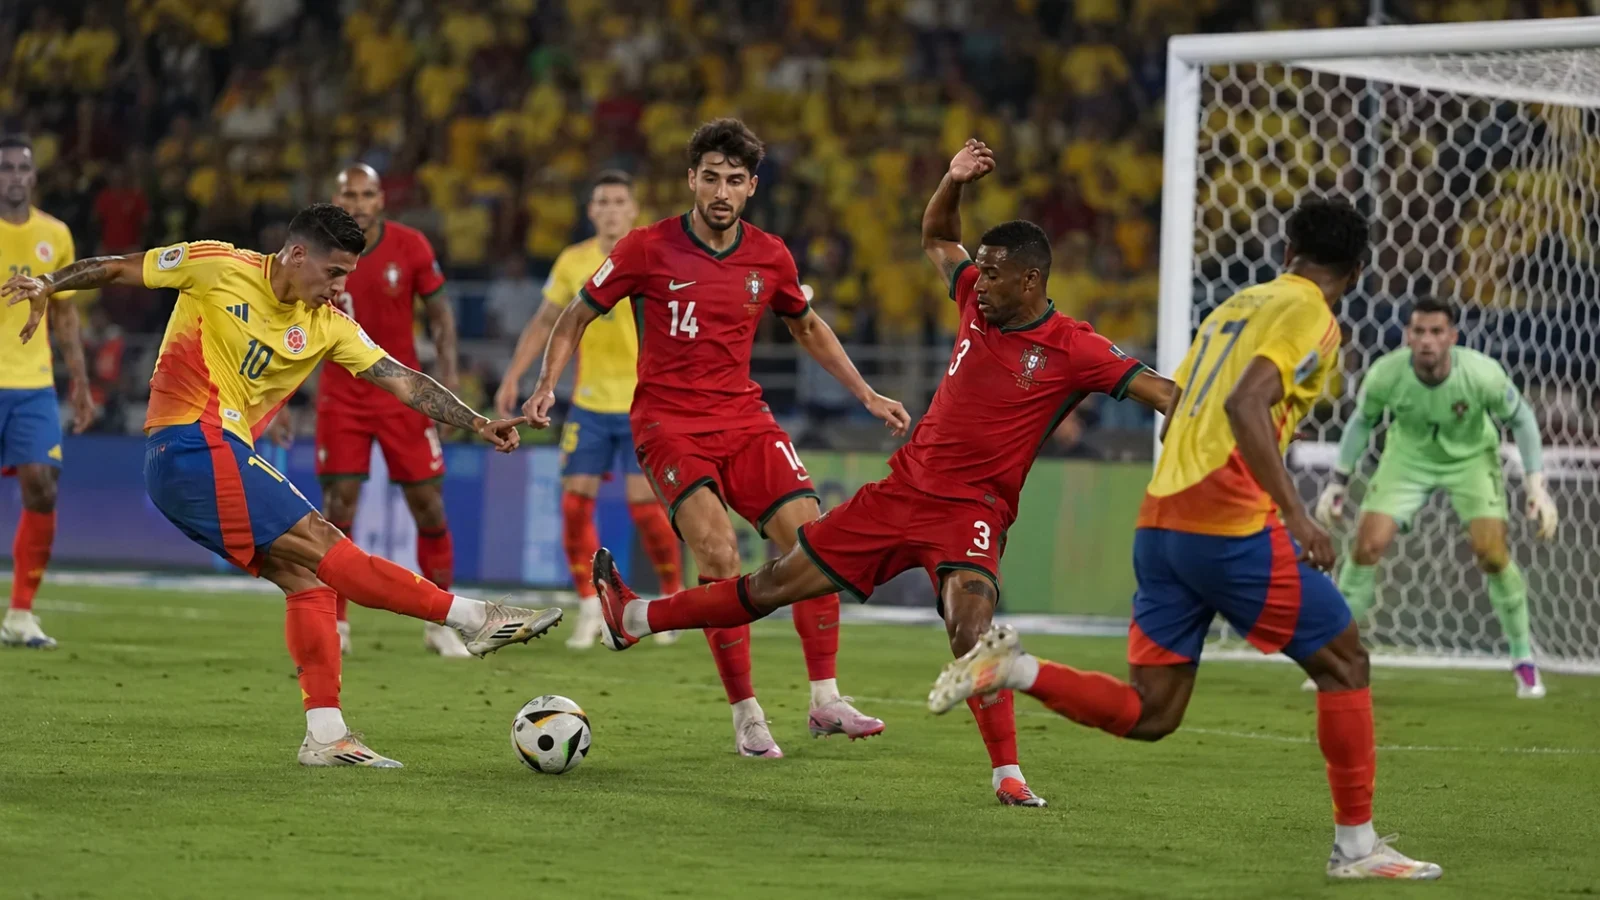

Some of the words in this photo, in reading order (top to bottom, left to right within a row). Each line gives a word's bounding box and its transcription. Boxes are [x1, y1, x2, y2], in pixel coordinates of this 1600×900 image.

[667, 300, 699, 338] 14
[239, 339, 274, 380] 10
[948, 338, 971, 376] 3
[1181, 318, 1249, 418] 17
[973, 520, 991, 551] 3
